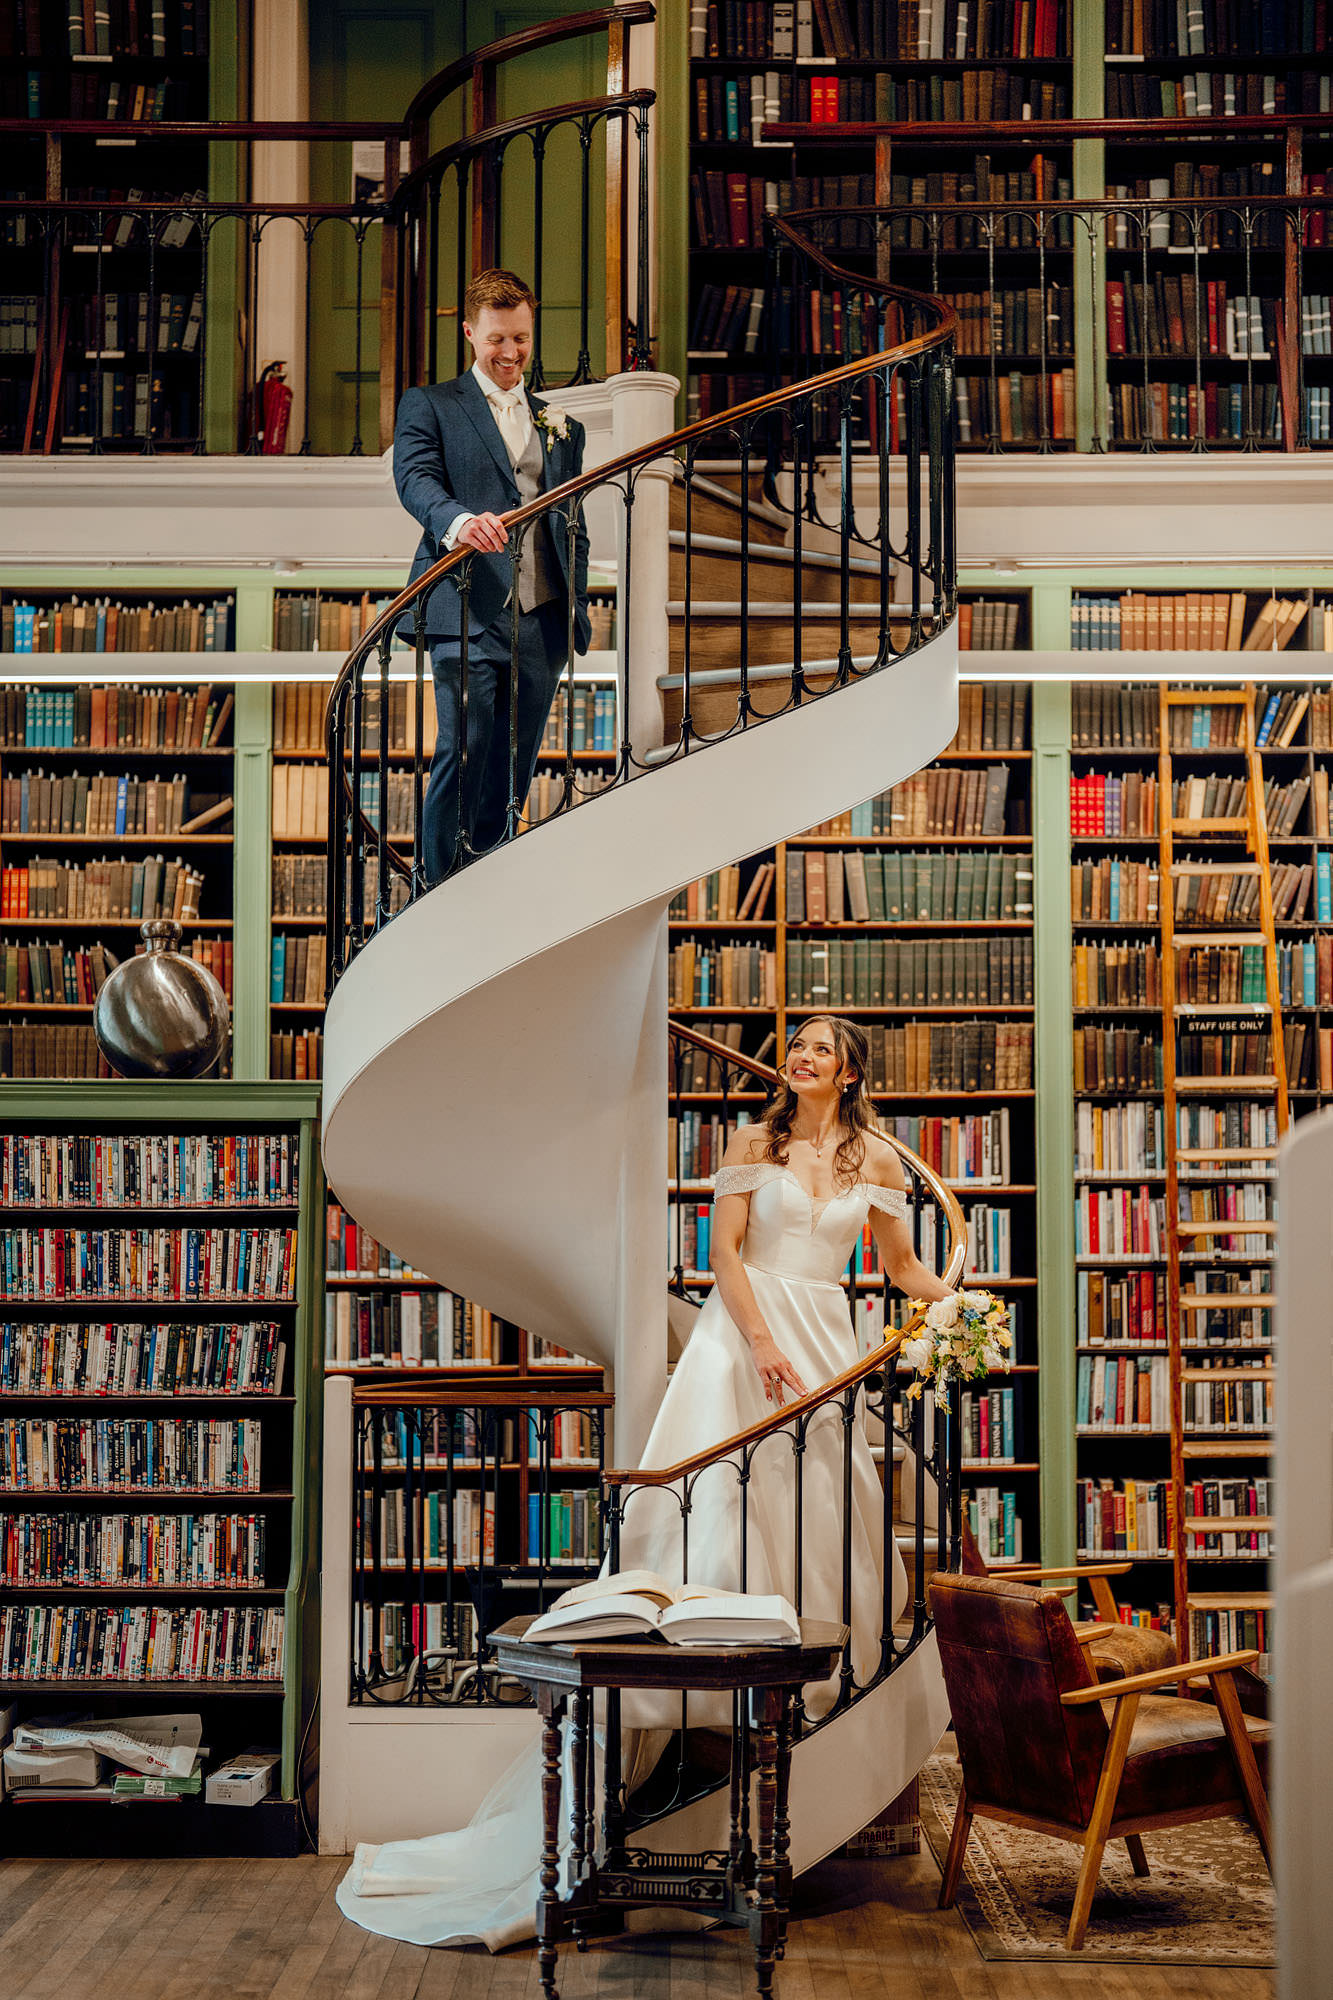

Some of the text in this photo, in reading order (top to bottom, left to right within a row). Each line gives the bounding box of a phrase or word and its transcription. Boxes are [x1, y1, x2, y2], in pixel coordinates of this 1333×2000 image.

[1188, 1020, 1264, 1031] STAFF USE ONLY
